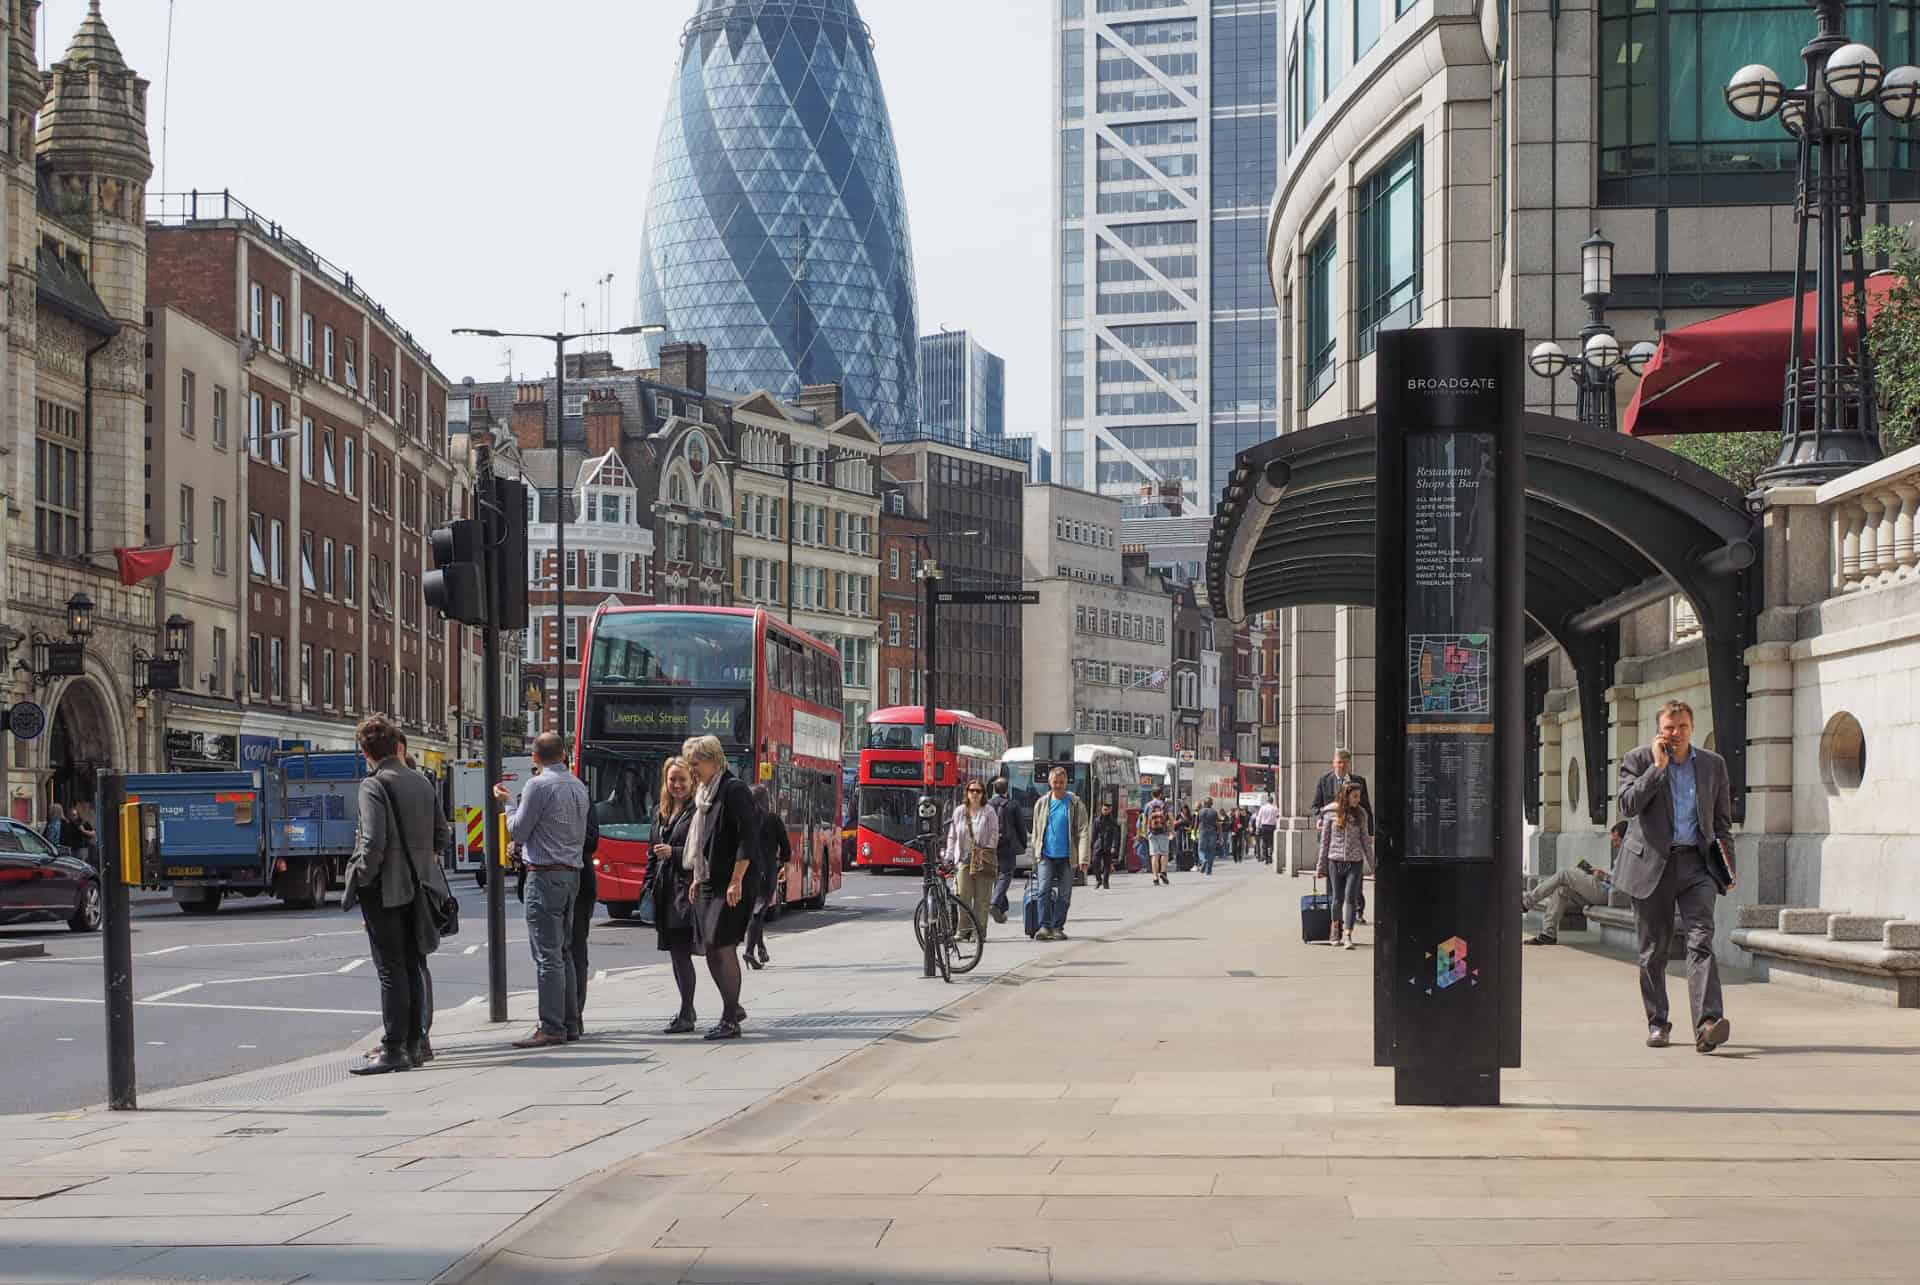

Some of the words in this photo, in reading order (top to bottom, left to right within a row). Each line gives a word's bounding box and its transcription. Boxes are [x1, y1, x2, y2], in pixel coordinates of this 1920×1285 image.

[1407, 378, 1496, 390] BROADGATE
[1416, 466, 1472, 477] Restaurants
[1416, 479, 1445, 491] Shops
[1447, 479, 1455, 489] &
[1458, 478, 1480, 489] Bars
[612, 711, 655, 724] Liverpool
[659, 712, 689, 724] Street
[702, 708, 730, 729] 344
